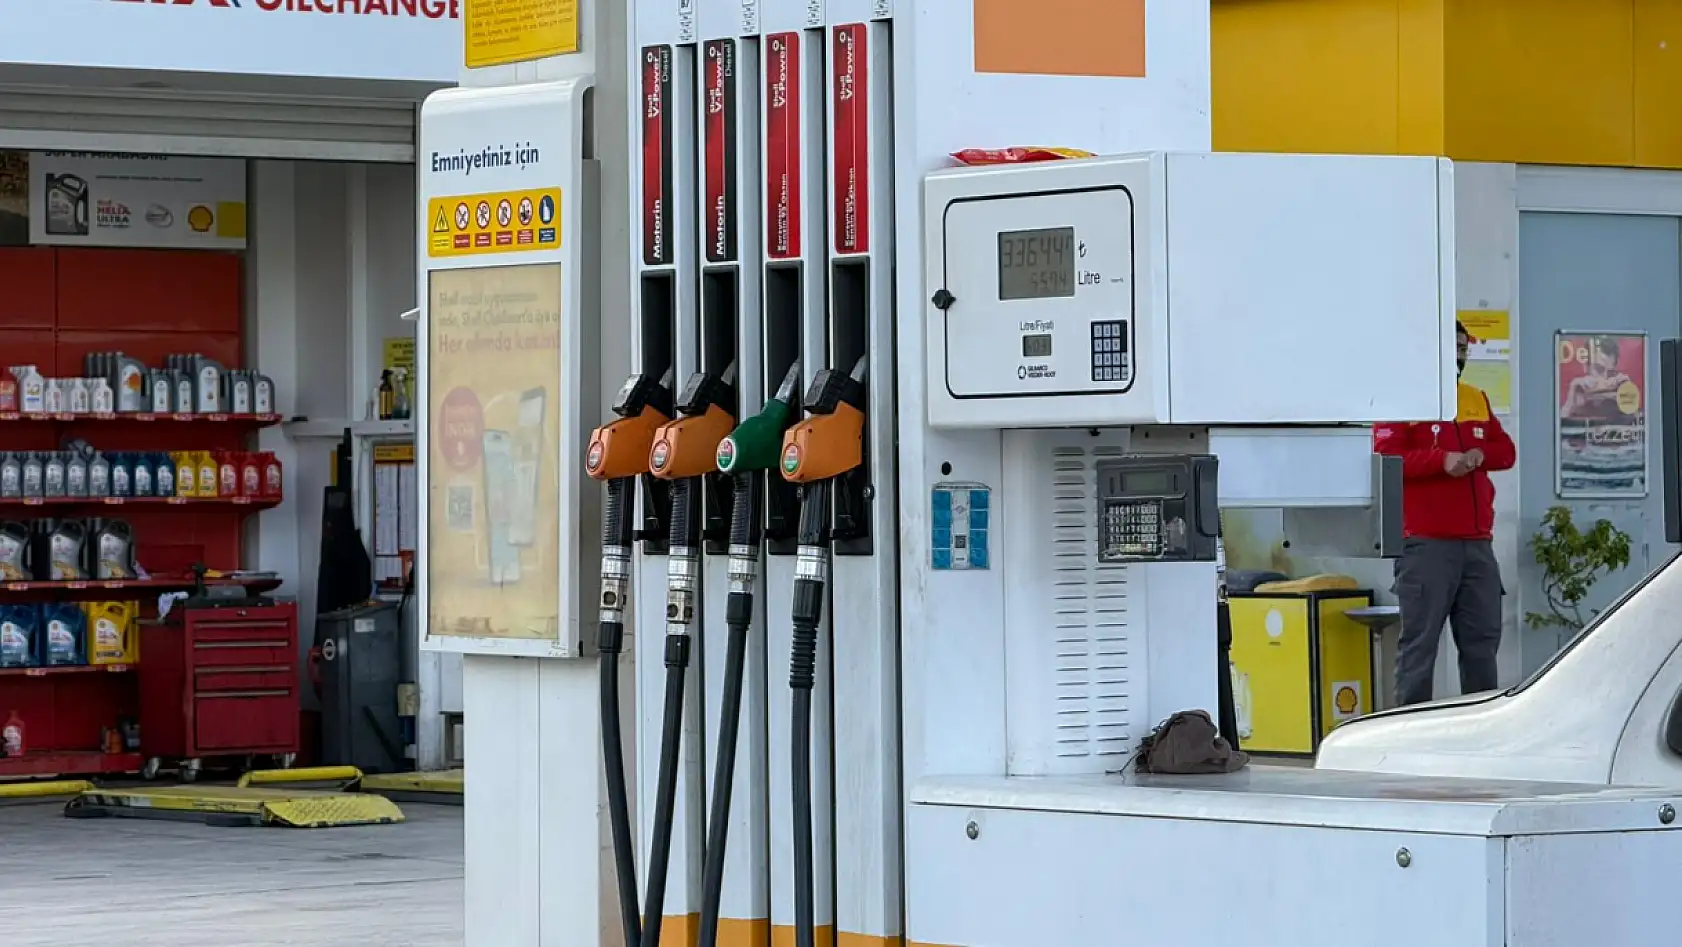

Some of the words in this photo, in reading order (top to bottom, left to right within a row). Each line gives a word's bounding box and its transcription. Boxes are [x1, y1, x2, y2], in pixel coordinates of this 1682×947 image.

[715, 50, 723, 113] V-Power
[724, 44, 732, 77] Diesel
[845, 36, 853, 101] V-Power
[652, 57, 660, 118] V-Power
[432, 143, 511, 176] Emniyetiniz
[515, 141, 539, 171] için
[652, 199, 660, 259] Motorin
[715, 195, 724, 254] Motorin
[1078, 270, 1100, 286] Litre
[439, 333, 463, 353] Her
[1559, 338, 1600, 364] Deli
